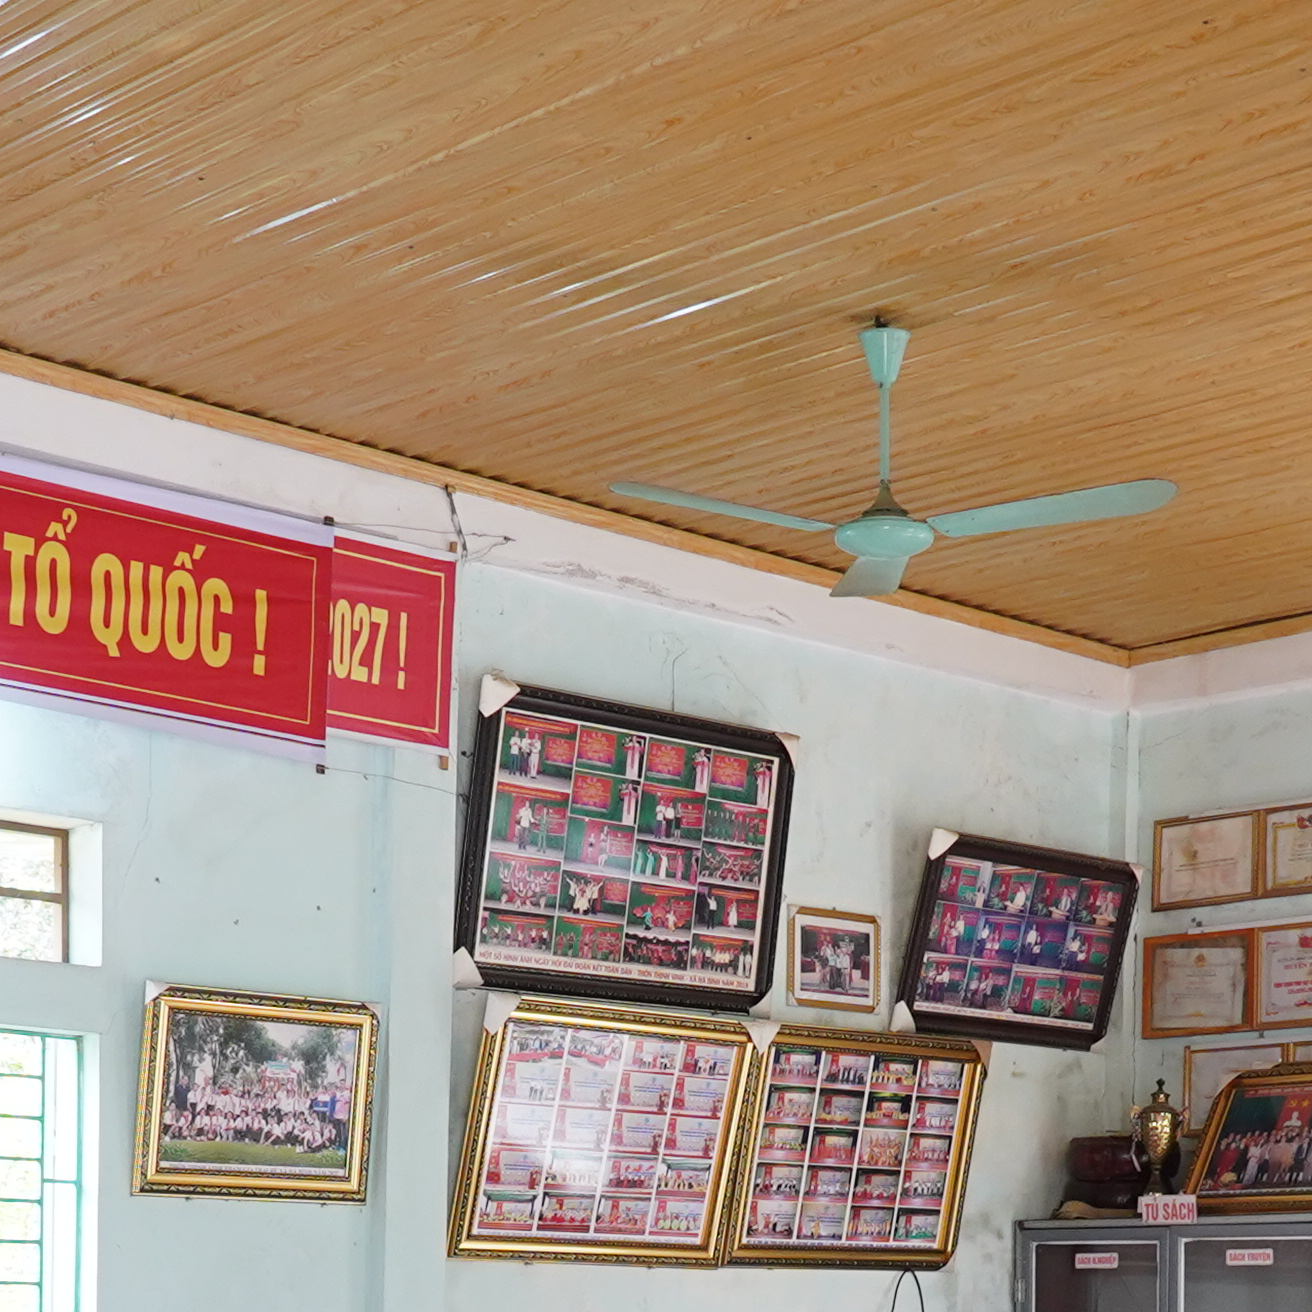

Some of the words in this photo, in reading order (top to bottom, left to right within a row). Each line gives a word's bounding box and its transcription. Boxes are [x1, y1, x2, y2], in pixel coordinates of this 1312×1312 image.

[4, 509, 78, 634] TỔ
[91, 545, 233, 667] QUỐC
[252, 588, 268, 677] !
[328, 598, 389, 685] 027
[397, 611, 408, 690] !
[1144, 1196, 1159, 1221] TỦ
[1163, 1196, 1195, 1221] SÁCH
